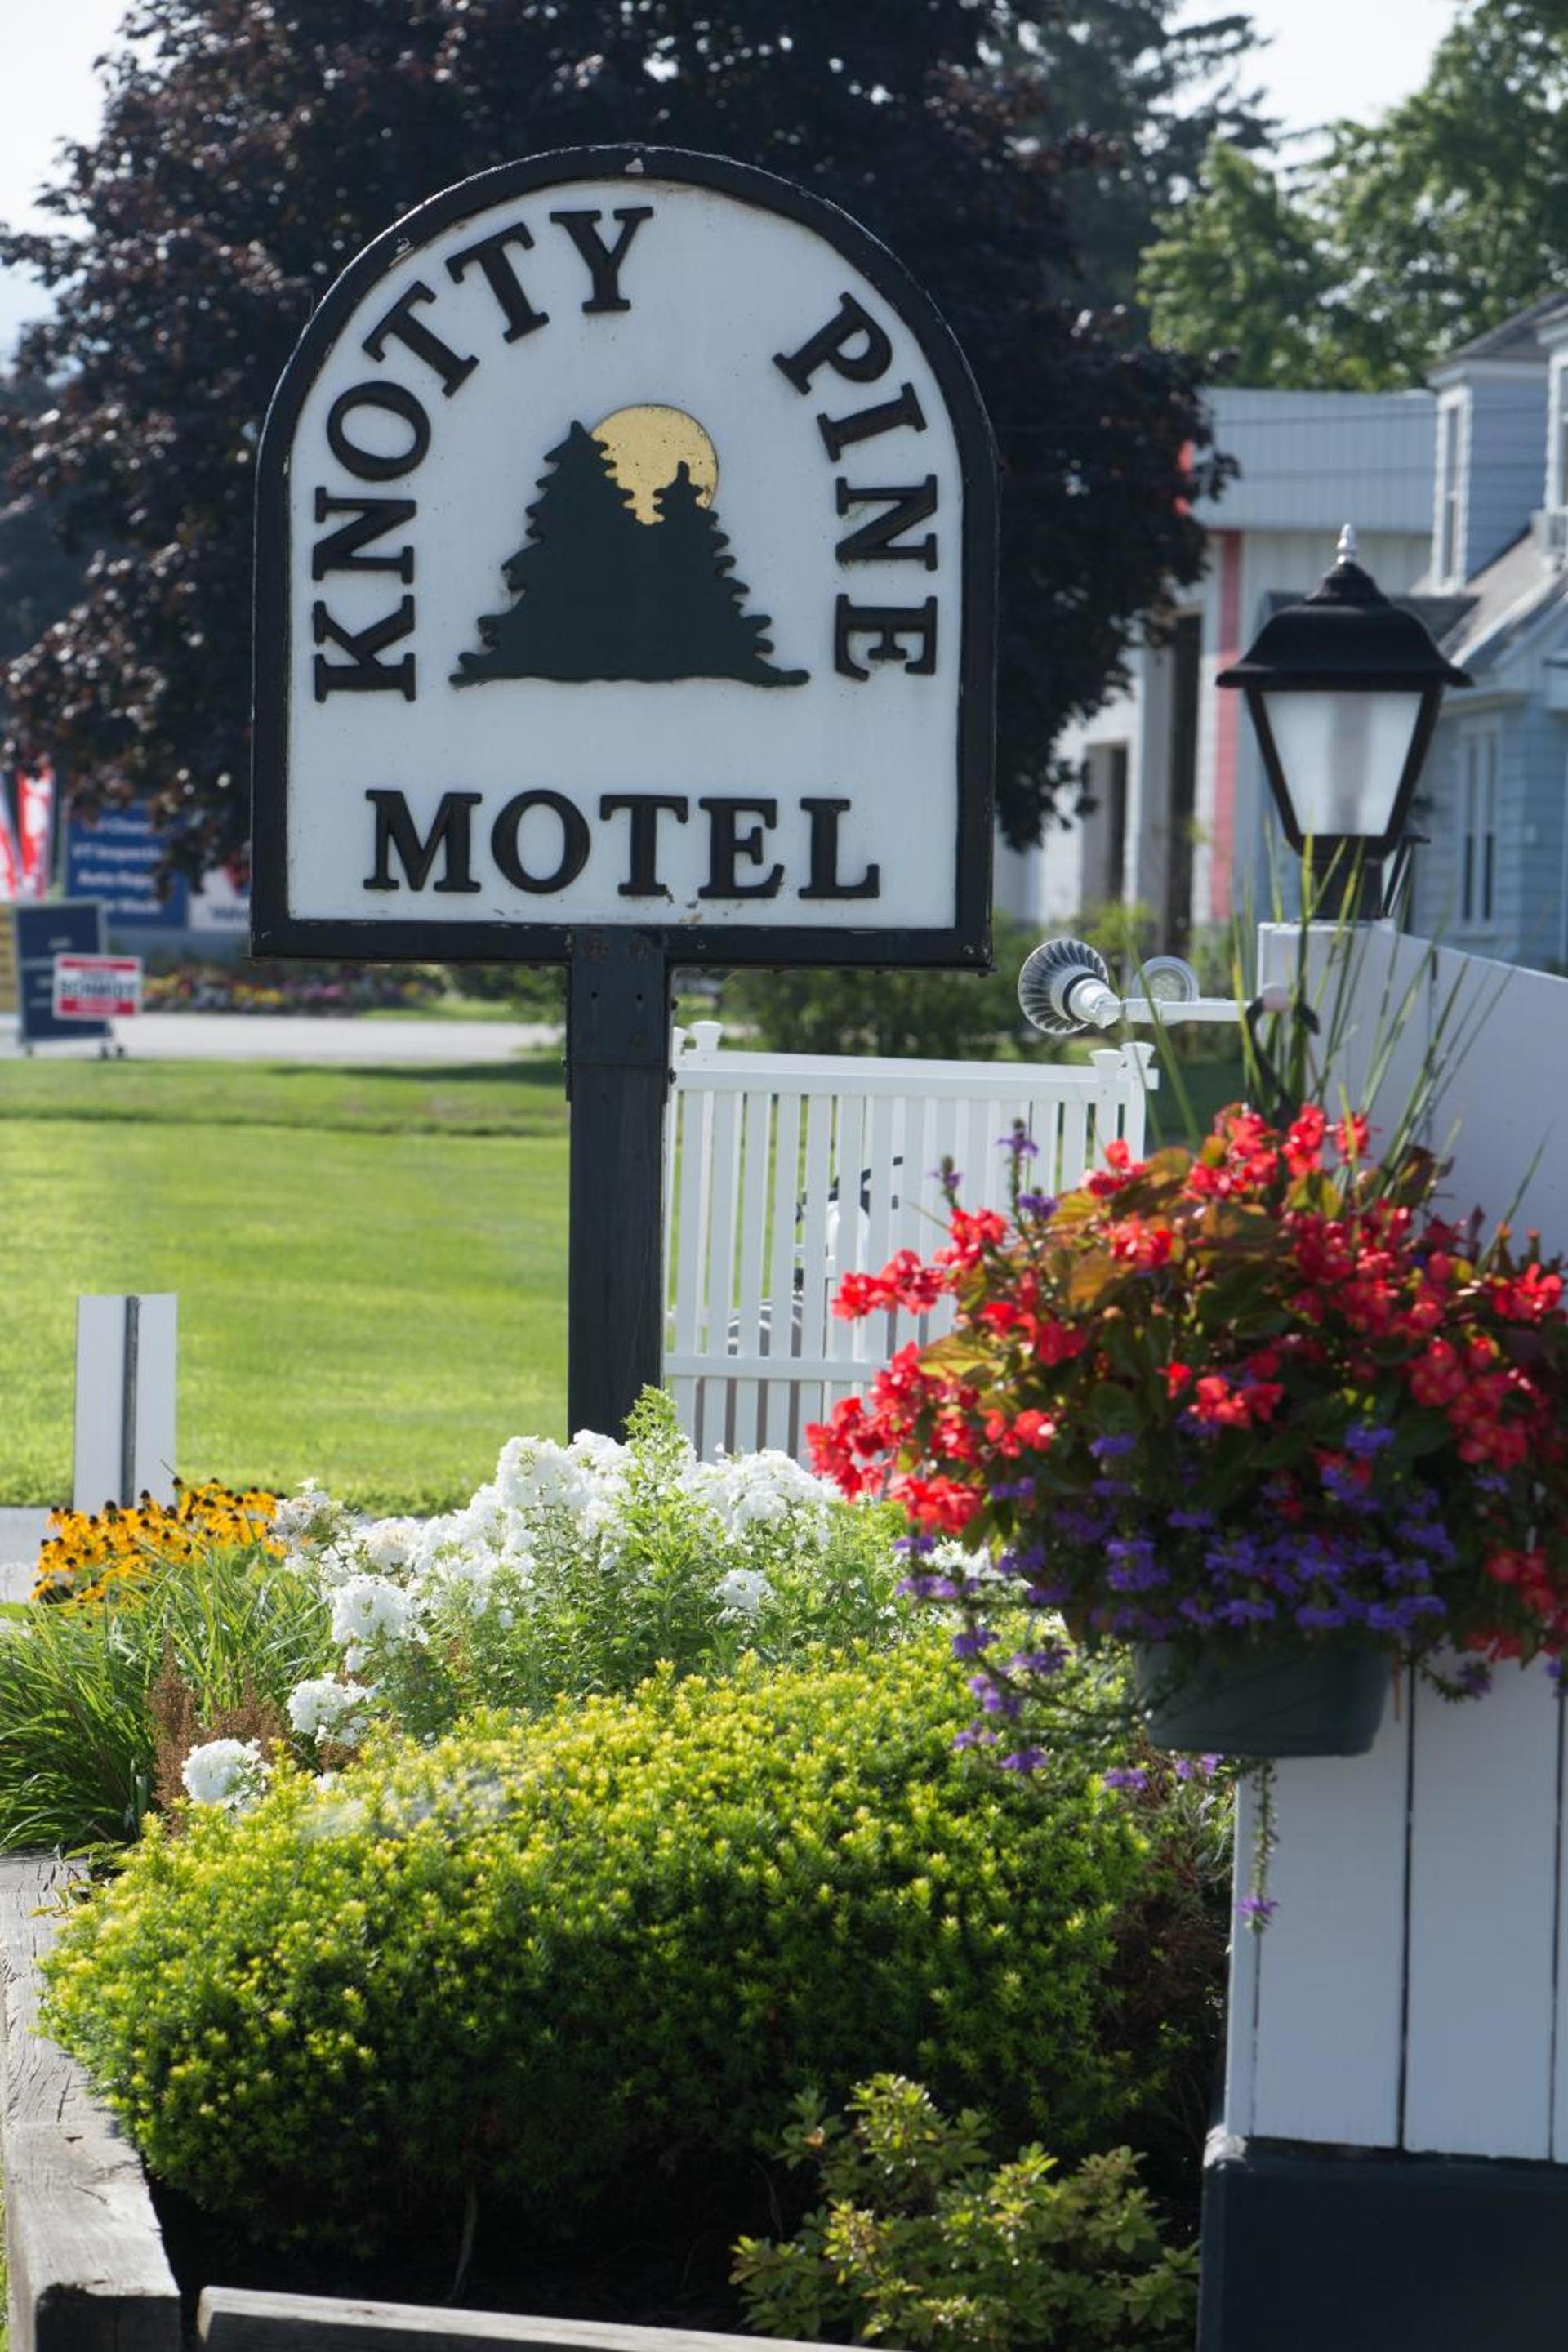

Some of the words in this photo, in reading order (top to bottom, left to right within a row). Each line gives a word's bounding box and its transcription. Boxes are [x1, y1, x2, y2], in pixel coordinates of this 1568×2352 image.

[311, 206, 653, 702] KNOTTY
[772, 292, 938, 681] PINE
[363, 789, 880, 900] MOTEL
